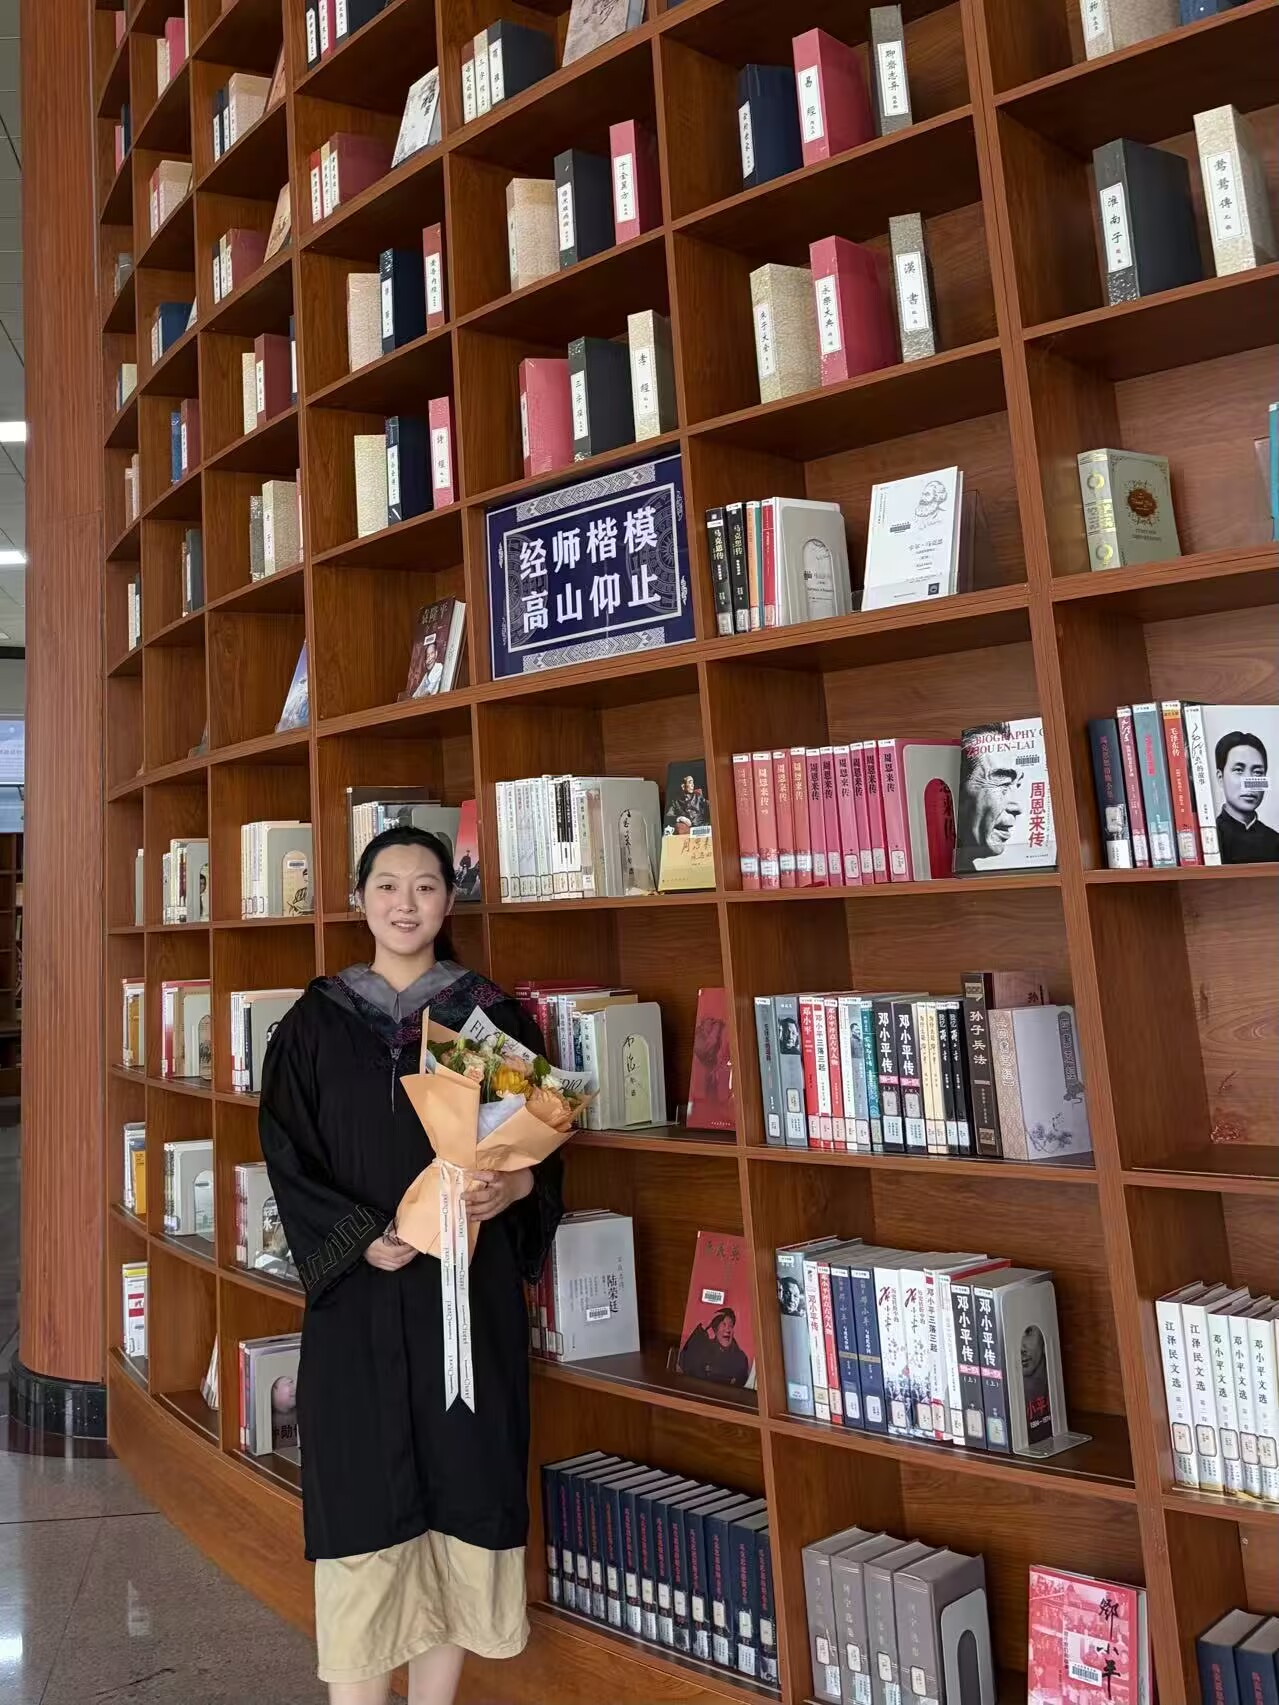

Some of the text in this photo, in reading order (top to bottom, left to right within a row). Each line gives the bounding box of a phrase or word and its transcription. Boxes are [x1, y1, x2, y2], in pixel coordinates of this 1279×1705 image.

[519, 506, 658, 580] 经师楷模
[521, 564, 661, 634] 高山仰止
[975, 728, 1037, 745] BIOGRAPHY
[1028, 781, 1046, 848] 周恩来传
[877, 1012, 893, 1073] 邓小平传
[898, 1014, 915, 1075] 邓小平传
[969, 1011, 987, 1065] 孙子兵法
[957, 1295, 974, 1363] 邓小平传
[979, 1298, 996, 1366] 邓小平传
[1164, 1321, 1182, 1388] 江泽民文选
[1190, 1323, 1206, 1391] 江泽民文选
[1213, 1334, 1228, 1398] 邓小平文选
[1232, 1335, 1248, 1400] 邓小平文选
[1254, 1338, 1268, 1404] 邓小平文选
